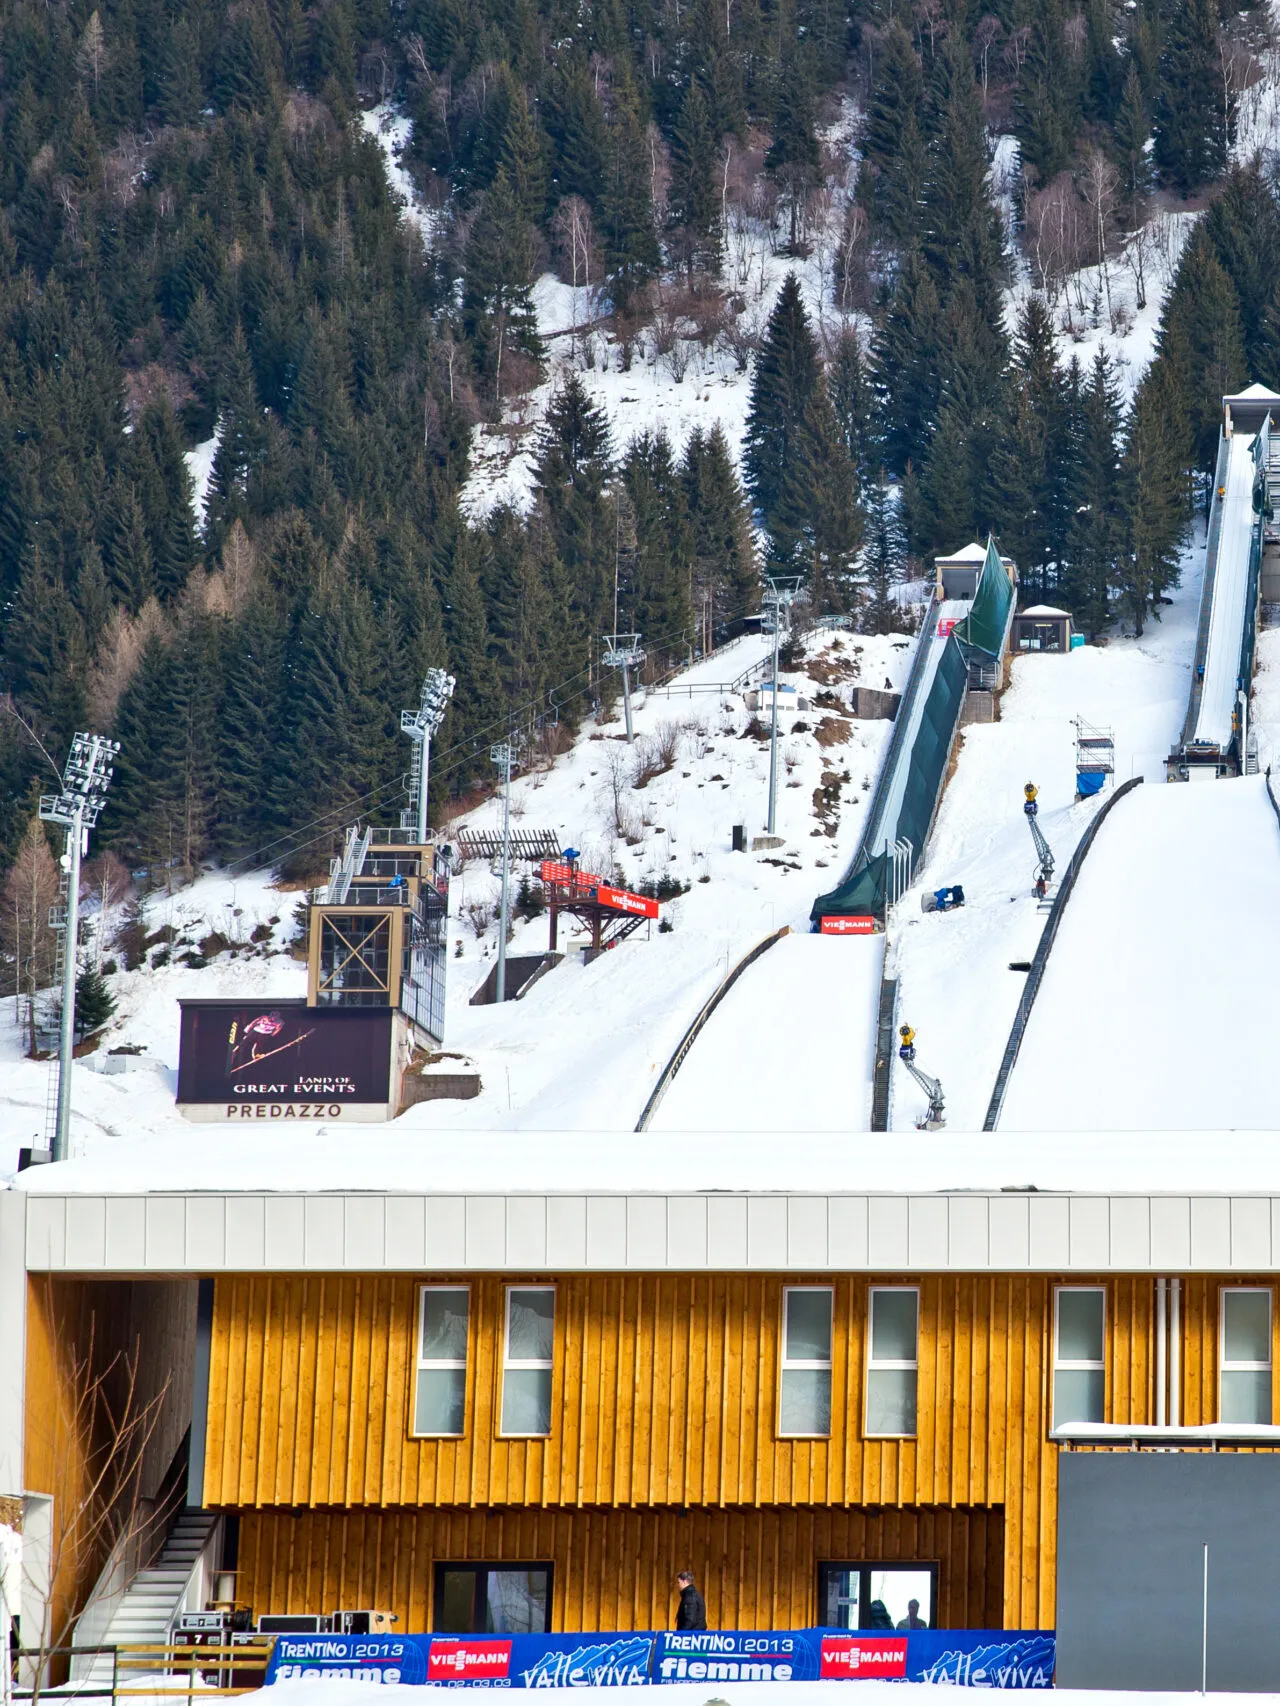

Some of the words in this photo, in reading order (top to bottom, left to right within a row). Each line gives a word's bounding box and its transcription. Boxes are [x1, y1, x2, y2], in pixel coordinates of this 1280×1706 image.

[233, 1084, 288, 1093] GREAT
[294, 1084, 356, 1093] EVENTS
[299, 1076, 332, 1084] LAND
[227, 1104, 341, 1118] PREDAZZO
[195, 1634, 202, 1645] 7
[664, 1633, 735, 1651] TRENTINO
[744, 1638, 794, 1652] 2013
[280, 1641, 347, 1658] TRENTINO
[355, 1643, 404, 1657] 2013
[823, 1647, 904, 1669] VIESSMANN
[431, 1649, 509, 1671] VIESSMANN
[660, 1658, 793, 1681] fiemme
